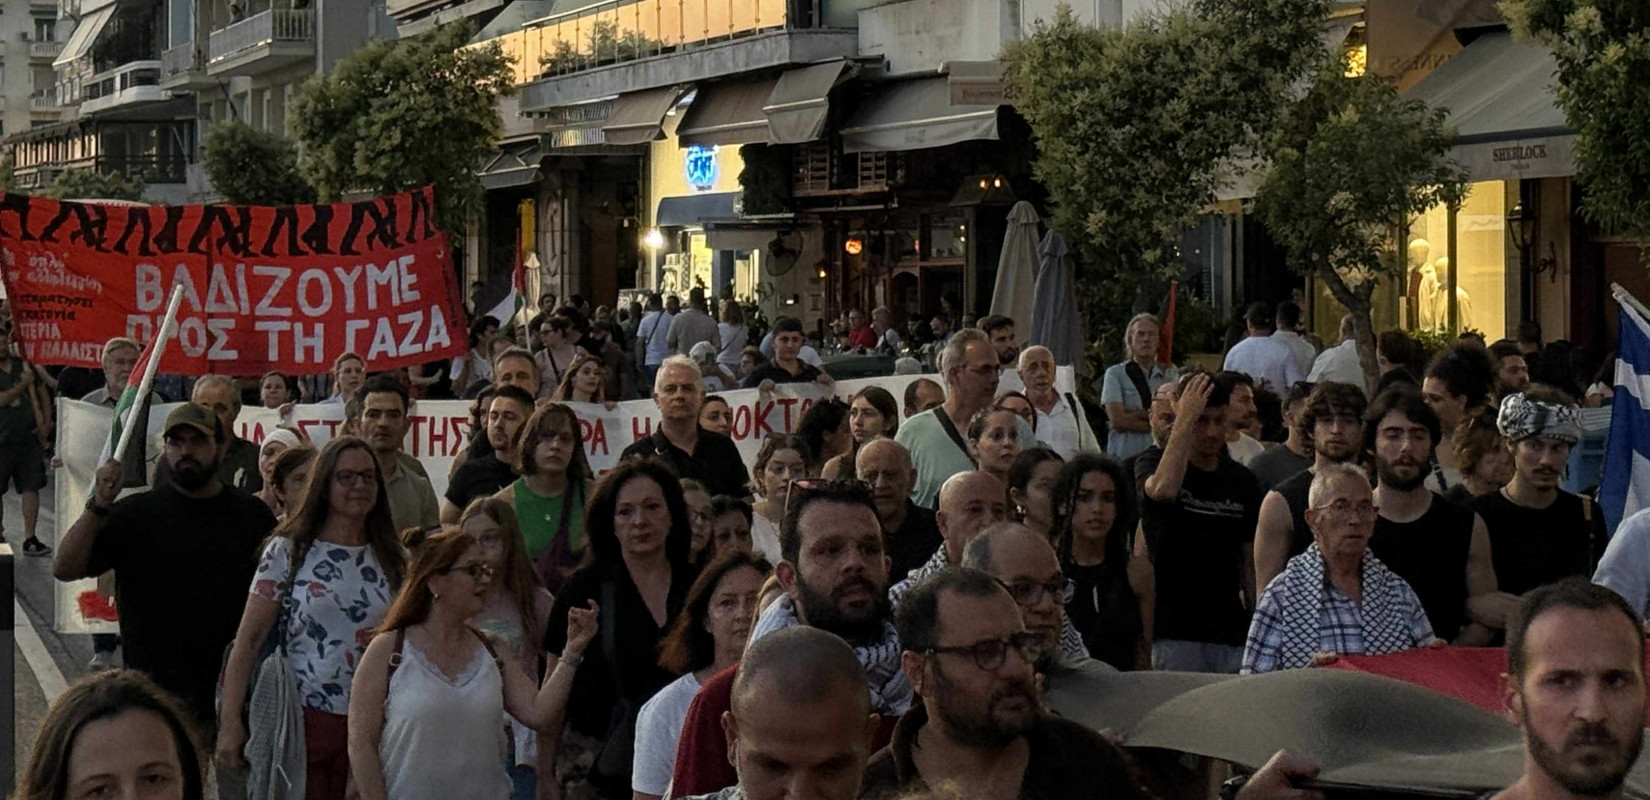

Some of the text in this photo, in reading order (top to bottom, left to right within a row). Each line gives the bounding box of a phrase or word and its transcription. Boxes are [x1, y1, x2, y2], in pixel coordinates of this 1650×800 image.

[1492, 144, 1547, 163] SHERLOCK
[134, 254, 421, 317] ΒΑΔΙΖΟΥΜΕ
[254, 319, 325, 364] ΤΗ
[344, 303, 452, 361] ΓΑΖΑ
[577, 418, 610, 456] ΡΑ
